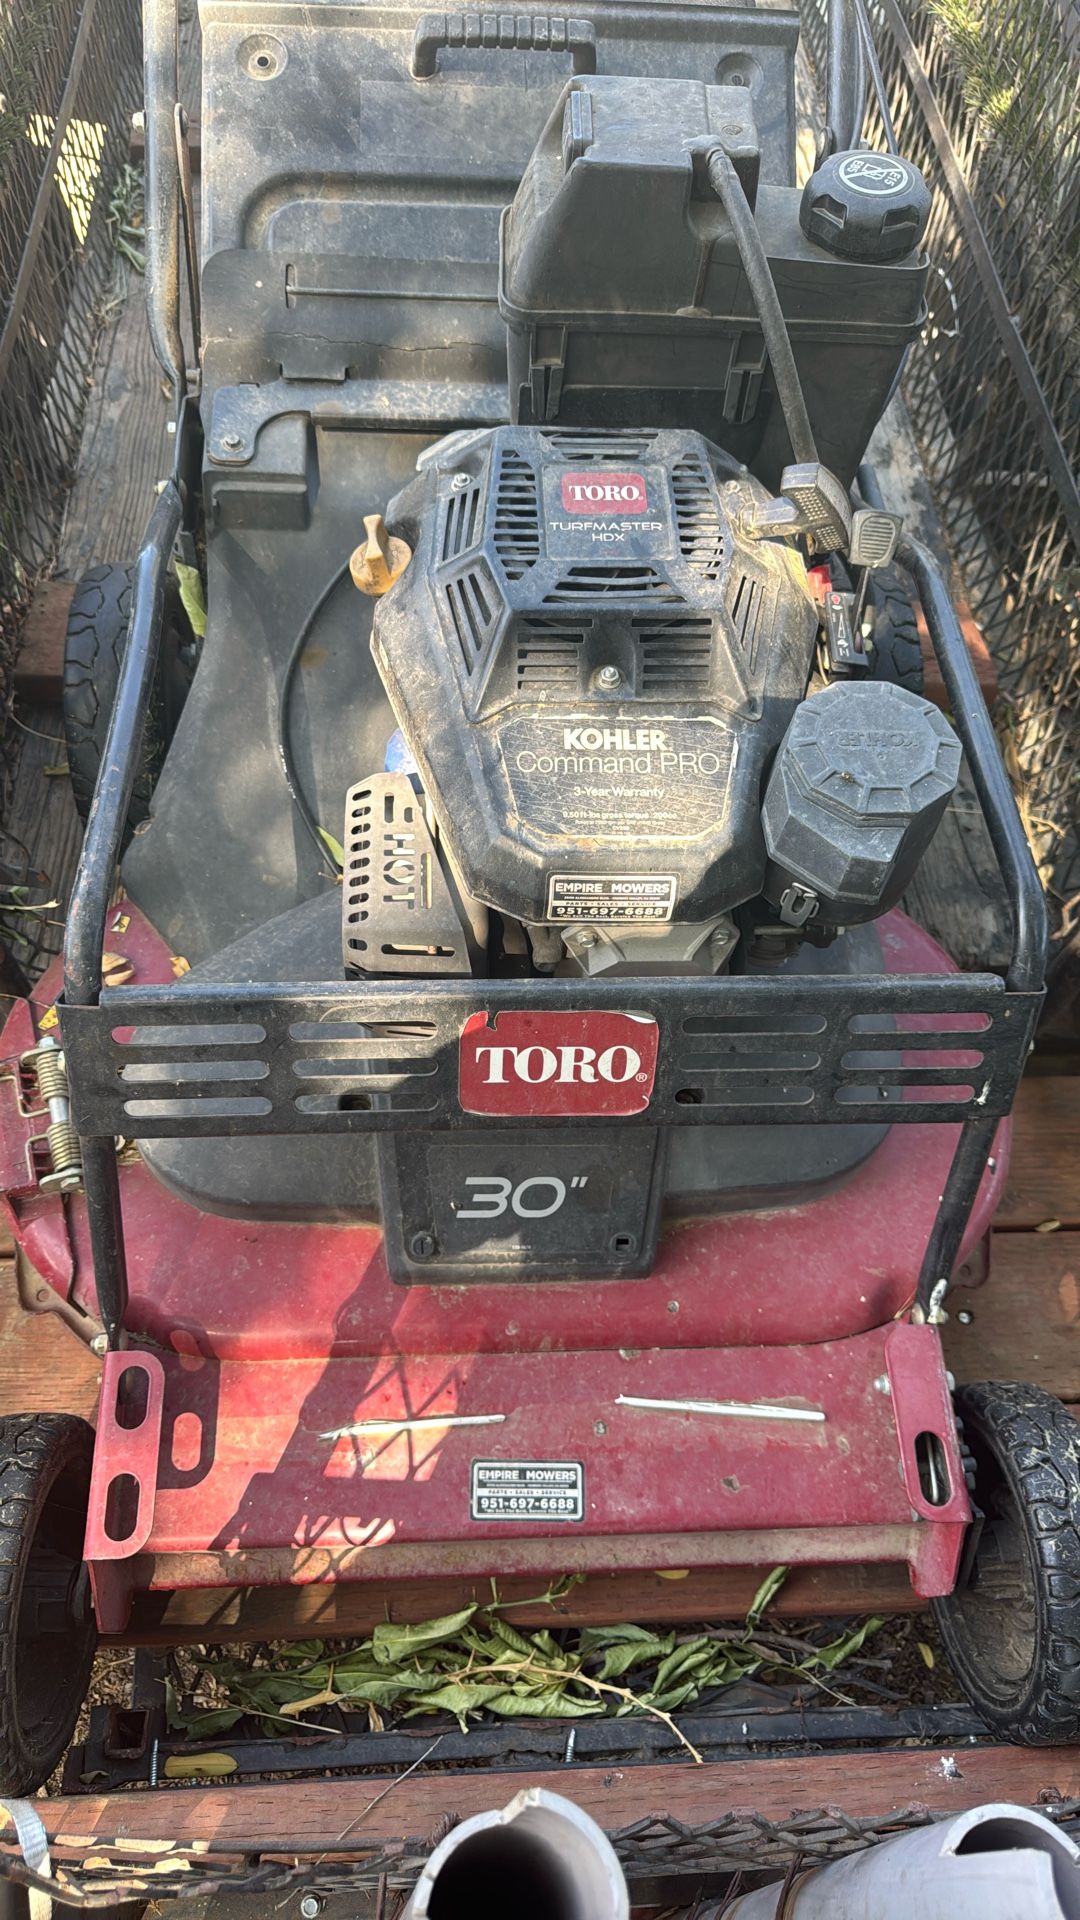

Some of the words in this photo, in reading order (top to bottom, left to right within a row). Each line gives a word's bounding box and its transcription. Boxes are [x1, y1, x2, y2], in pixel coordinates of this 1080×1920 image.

[884, 171, 902, 187] E15
[568, 485, 641, 501] TORO
[549, 521, 663, 532] TURFMASTER
[592, 533, 625, 542] HDX
[563, 728, 668, 751] KOHLER
[516, 750, 651, 774] Command
[660, 752, 720, 775] PRO
[574, 787, 609, 798] 3-Year
[610, 787, 665, 799] Warranty
[383, 833, 415, 910] HOT
[555, 883, 603, 893] EMPIRE
[611, 883, 670, 893] MOWERS
[556, 907, 663, 915] 951-697-6688
[475, 1045, 641, 1084] TORO
[456, 1176, 588, 1219] 30"
[479, 1470, 520, 1480] EMPIRE
[526, 1470, 576, 1480] MOWERS
[481, 1498, 574, 1509] 951-697-6688
